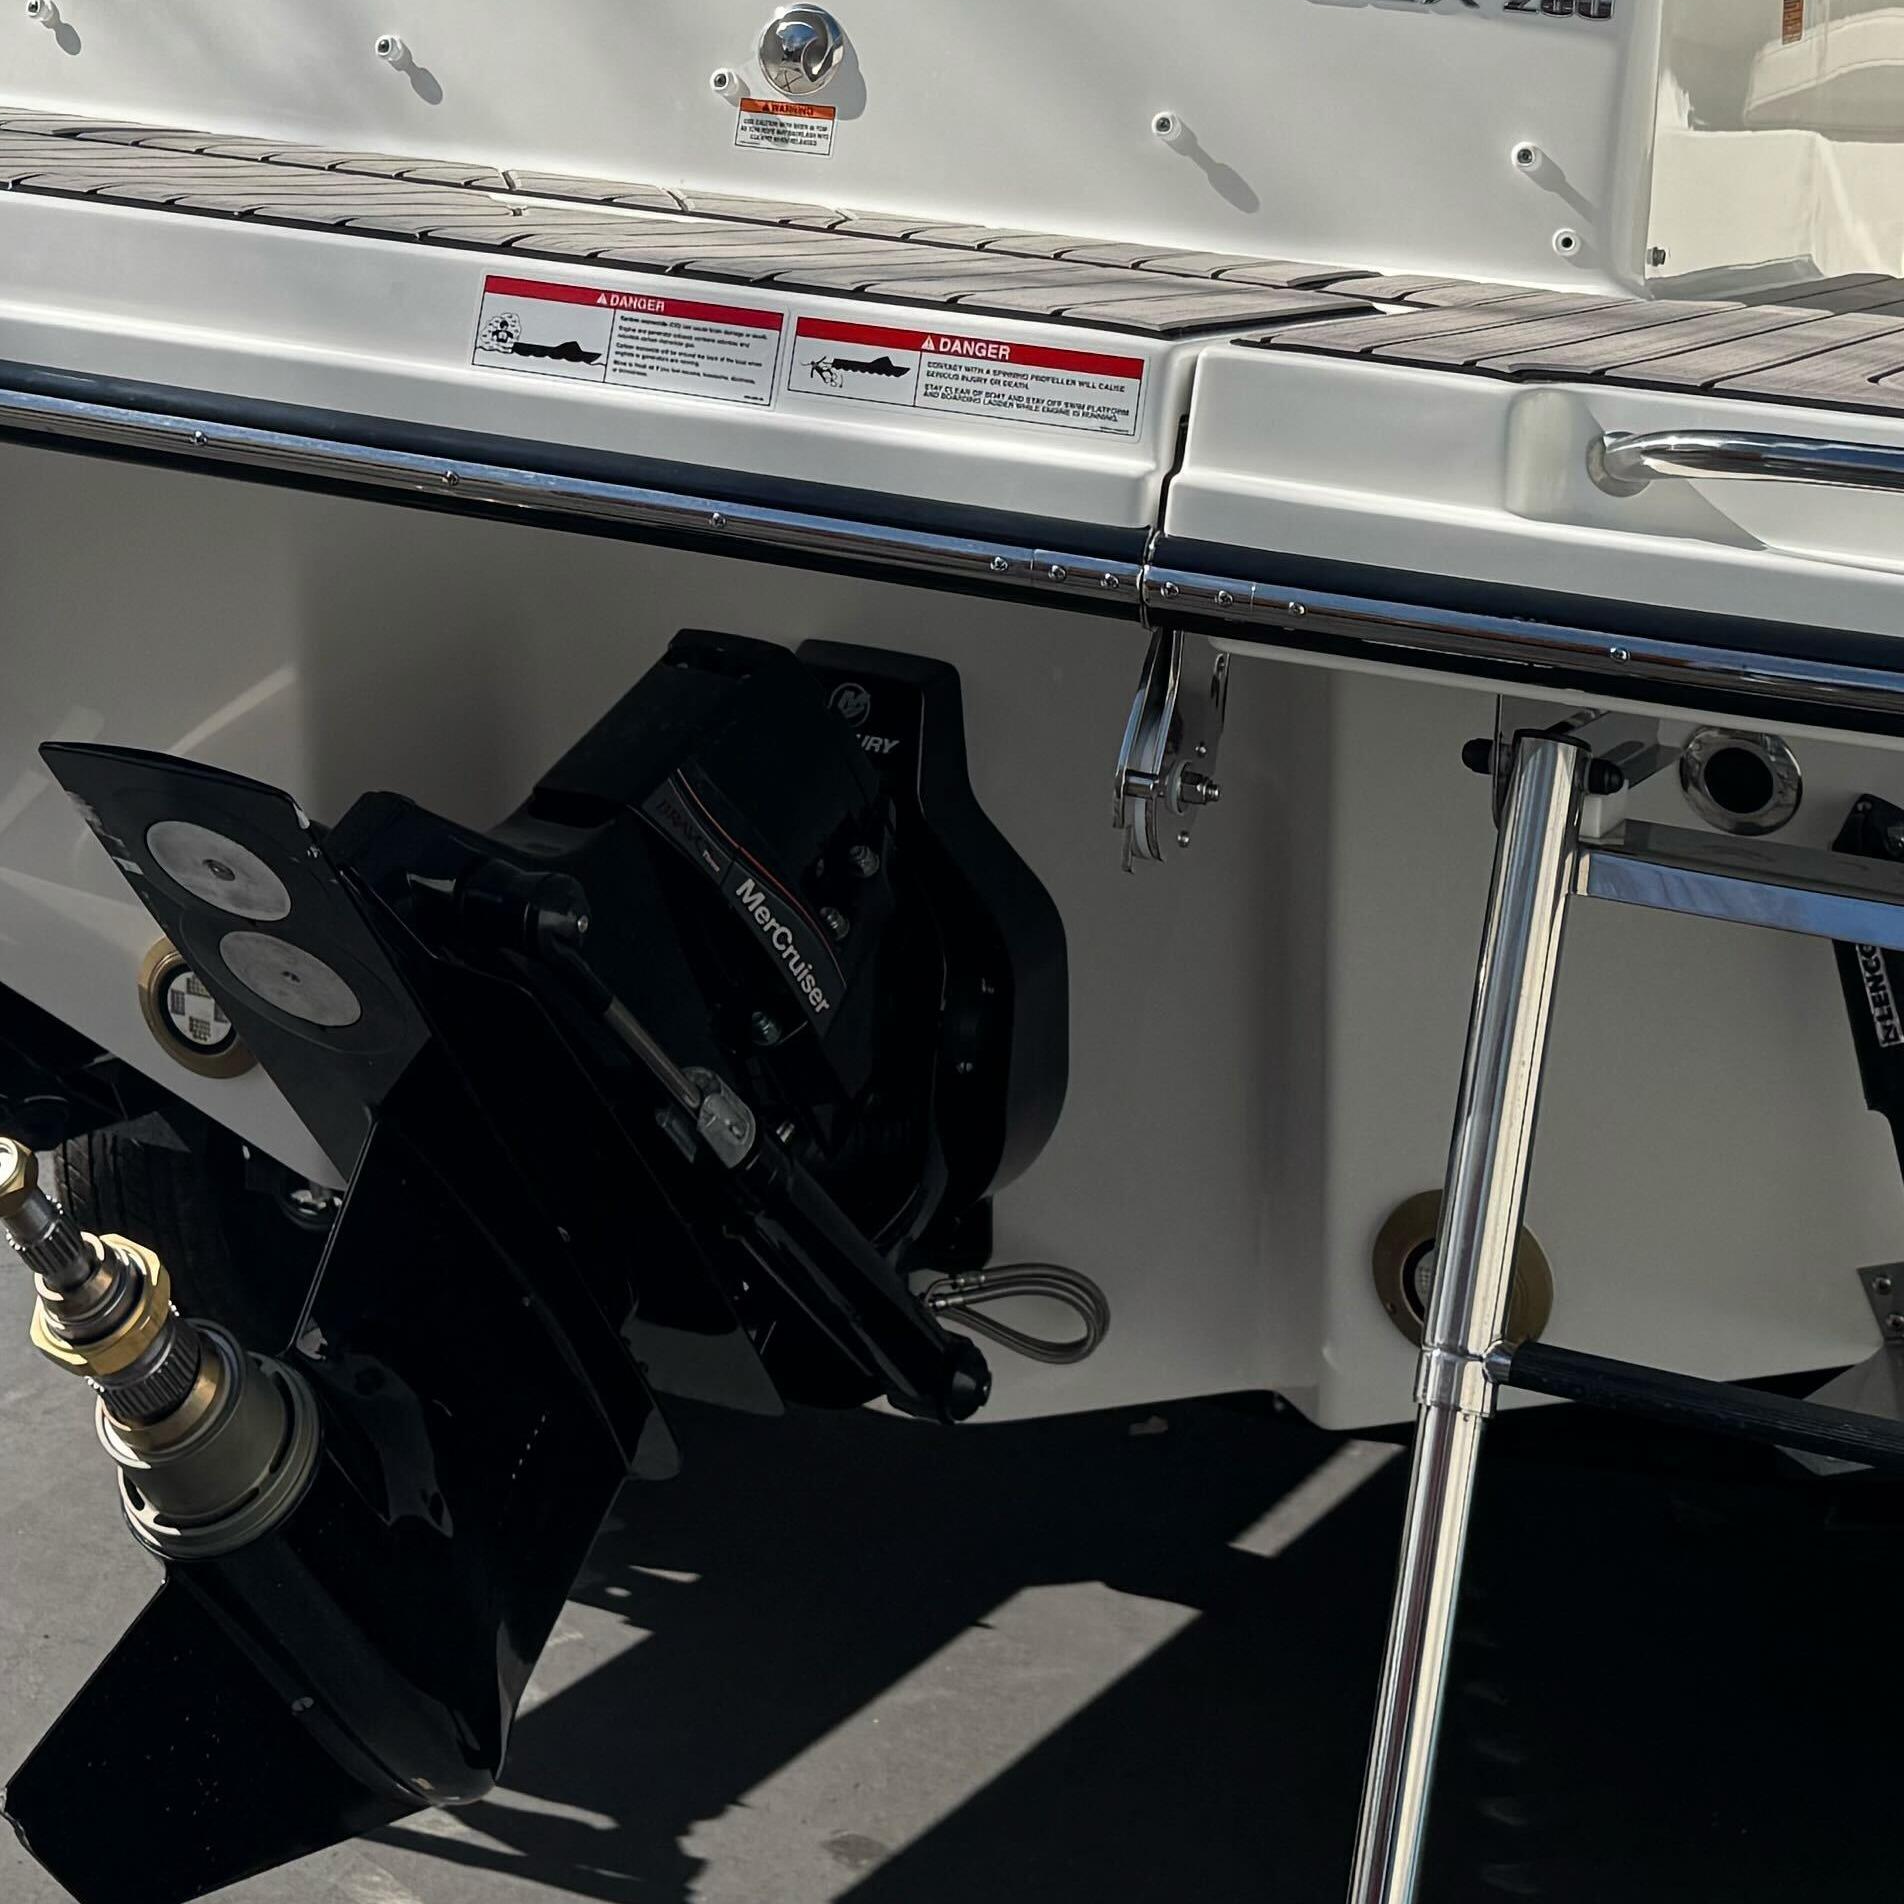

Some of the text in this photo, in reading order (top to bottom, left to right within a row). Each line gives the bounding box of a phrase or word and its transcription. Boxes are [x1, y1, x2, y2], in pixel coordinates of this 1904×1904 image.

[610, 297, 665, 312] DANGER
[939, 338, 1011, 360] DANGER
[735, 878, 830, 1013] MerCruiser
